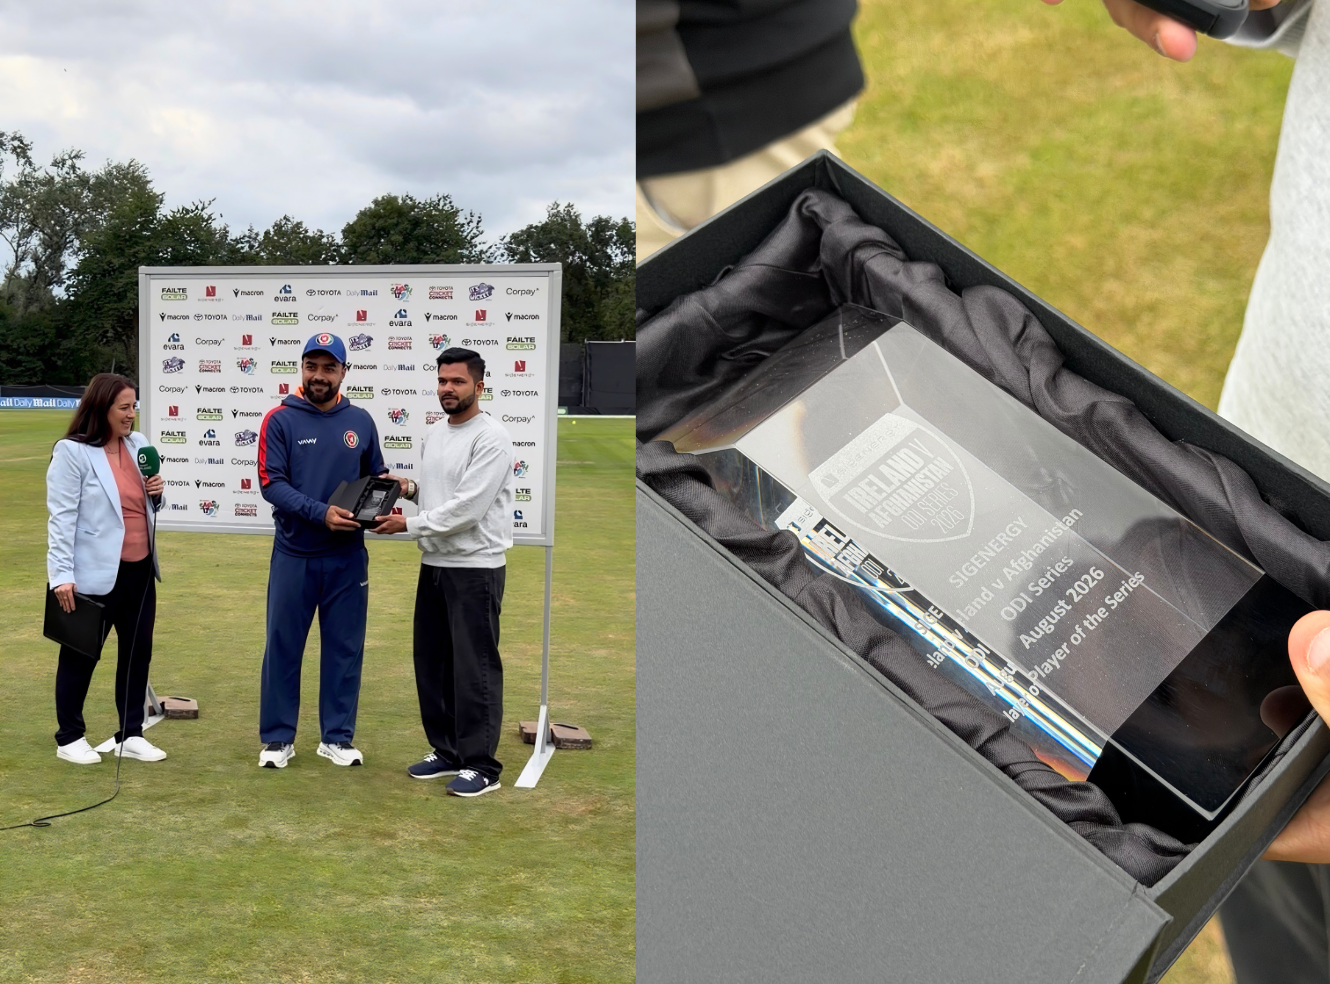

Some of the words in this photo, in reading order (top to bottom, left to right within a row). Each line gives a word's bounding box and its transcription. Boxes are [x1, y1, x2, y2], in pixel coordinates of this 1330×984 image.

[14, 399, 33, 408] Daily
[33, 398, 56, 407] Mail
[57, 399, 76, 408] Daily
[843, 447, 924, 514] IRELAND
[868, 456, 954, 529] AFGHANISTAN
[901, 500, 927, 530] ODI
[917, 482, 959, 516] SERIES
[930, 506, 964, 534] 2026
[949, 516, 1029, 589] SIGENERGY
[992, 579, 1005, 591] v
[1002, 507, 1083, 581] Afghanistan
[1000, 593, 1034, 622] ODI
[1028, 555, 1075, 597] Series
[1019, 599, 1073, 649] August
[1066, 566, 1105, 603] 2026
[1028, 643, 1071, 681] Player
[1071, 625, 1087, 645] of
[1084, 607, 1109, 630] the
[1105, 571, 1145, 610] Series
